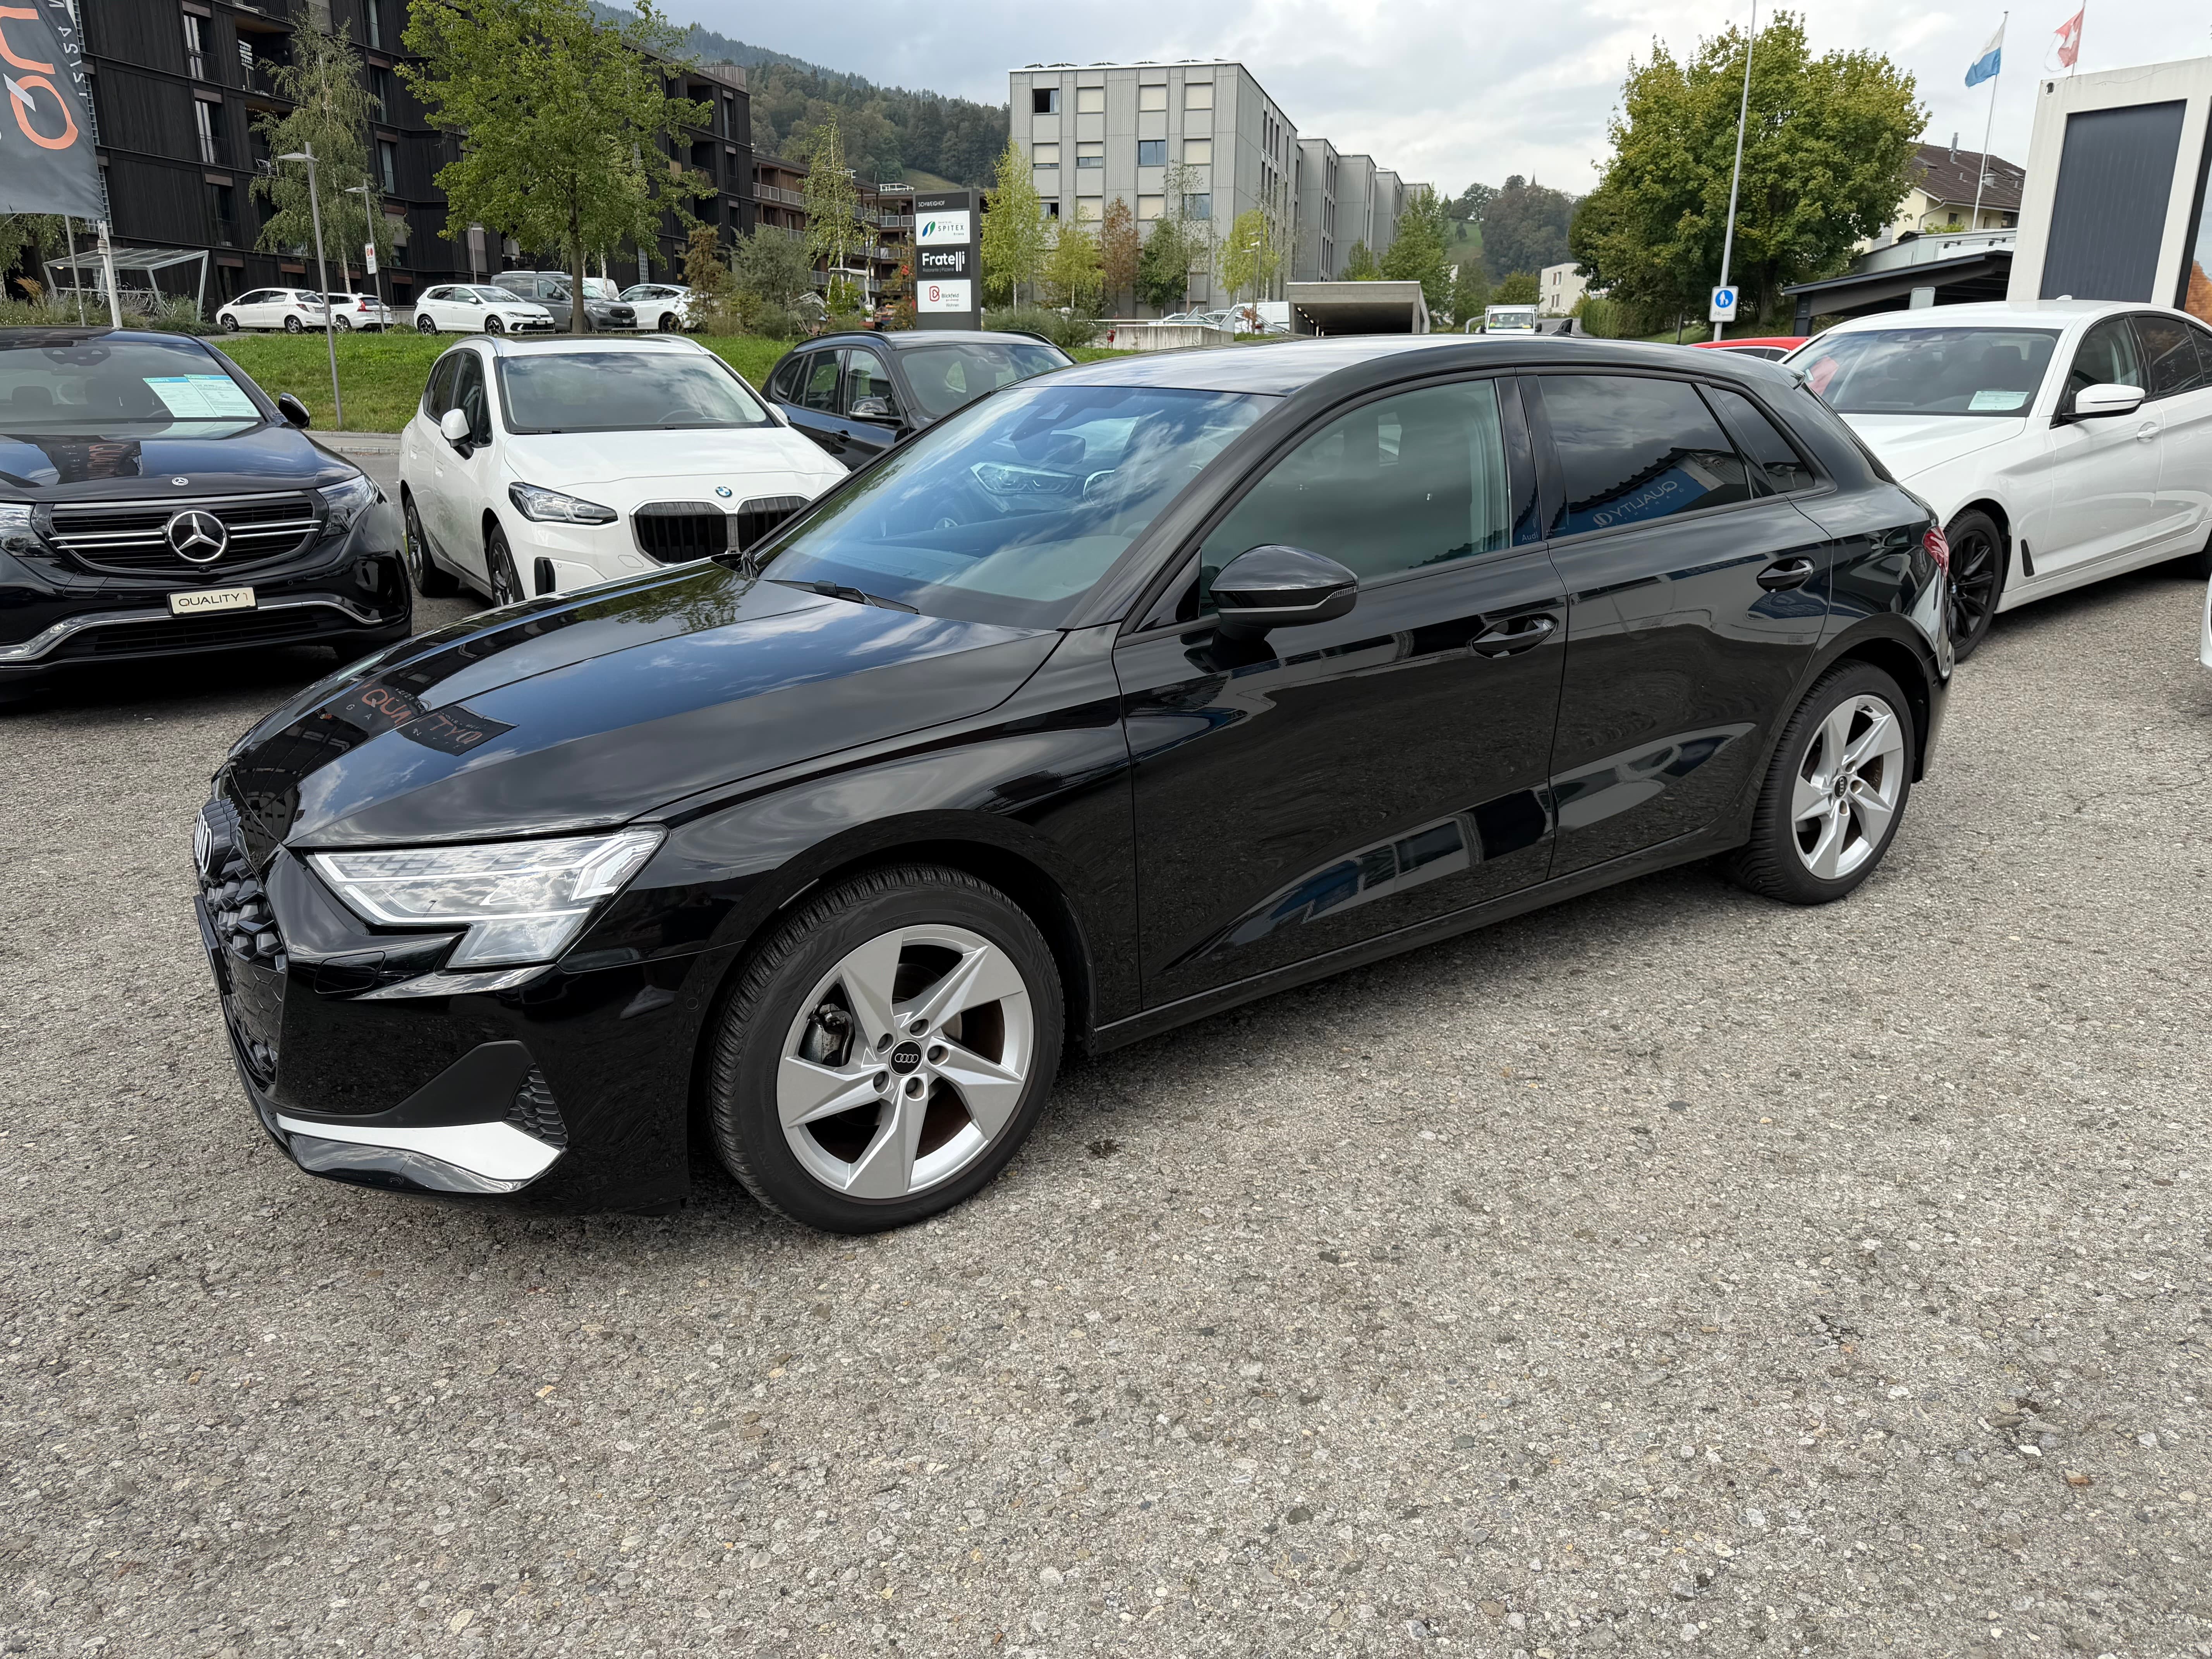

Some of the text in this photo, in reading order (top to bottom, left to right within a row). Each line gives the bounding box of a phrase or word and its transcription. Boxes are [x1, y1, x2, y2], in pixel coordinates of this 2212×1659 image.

[922, 251, 965, 272] Fratelli
[1522, 531, 1539, 542] Audi
[179, 593, 239, 607] QUALITY
